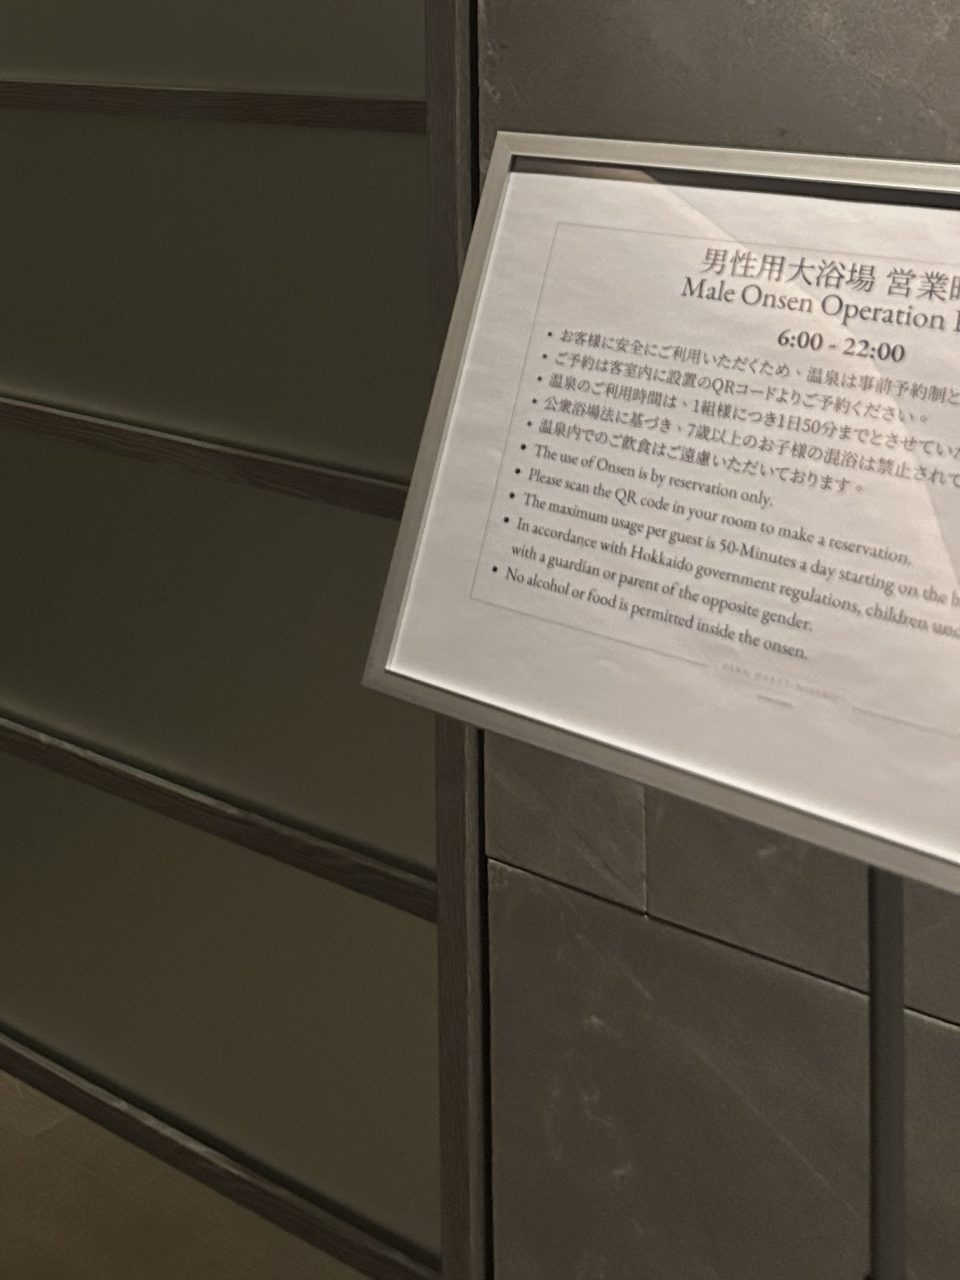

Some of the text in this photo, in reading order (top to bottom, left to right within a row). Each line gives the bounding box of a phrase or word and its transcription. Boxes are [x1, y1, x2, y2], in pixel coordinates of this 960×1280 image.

[680, 276, 735, 303] Male
[741, 284, 813, 313] Onsen
[821, 294, 946, 331] Operation
[701, 247, 876, 293] 男性用大浴場
[777, 328, 824, 351] 6:00
[842, 338, 905, 362] 22:00
[528, 468, 912, 566] Please scan the QR code in your room to make a reservation.
[535, 444, 773, 510] The use of Onsen is by reservation only.
[511, 544, 813, 631] with a guardian or parent of the opposite gender.
[517, 517, 529, 531] In
[532, 524, 598, 548] accordance
[600, 540, 627, 555] with
[630, 544, 693, 573] Hokkaido
[694, 564, 776, 592] government
[779, 584, 861, 616] regulations,
[865, 603, 929, 632] children
[524, 492, 546, 510] The
[548, 501, 608, 524] maximum
[611, 517, 644, 535] usage
[645, 524, 667, 540] per
[668, 530, 703, 546] guest
[706, 536, 715, 549] is
[719, 538, 796, 568] 50-Minutes
[799, 560, 807, 571] a
[810, 559, 836, 581] day
[839, 569, 894, 597] starting
[897, 584, 919, 597] on
[922, 584, 948, 605] the
[505, 566, 808, 660] No alcohol or food is permitted inside the onsen.
